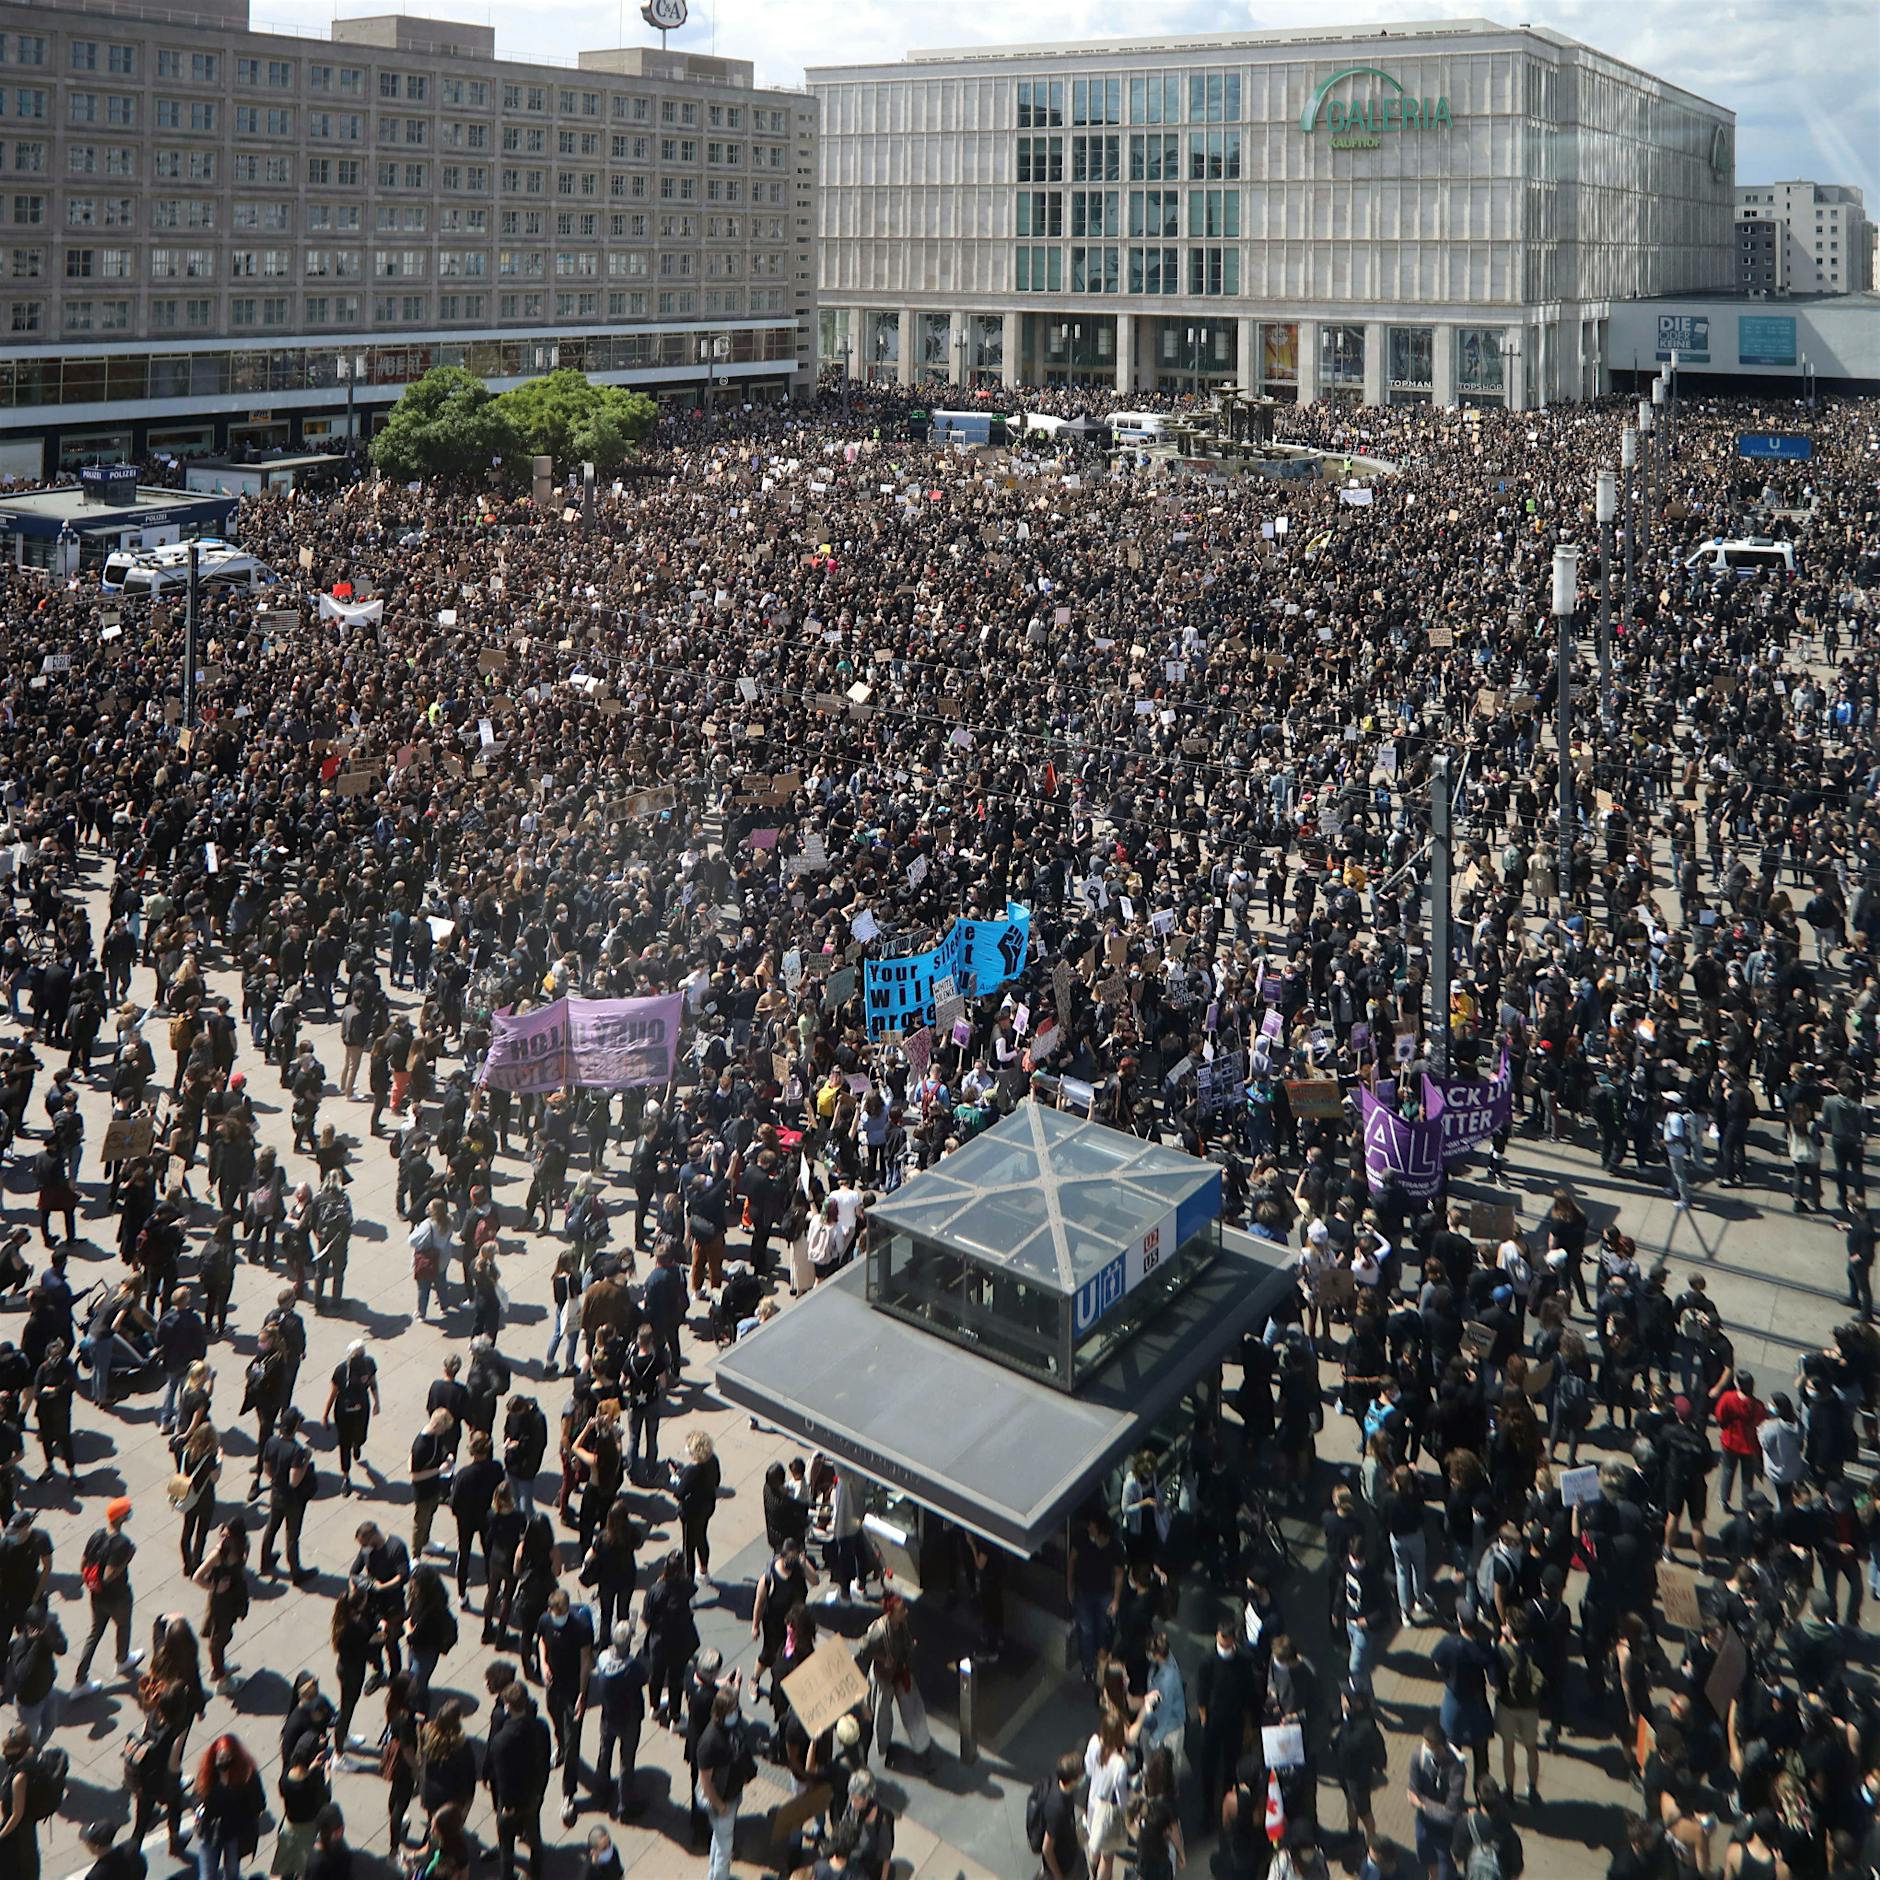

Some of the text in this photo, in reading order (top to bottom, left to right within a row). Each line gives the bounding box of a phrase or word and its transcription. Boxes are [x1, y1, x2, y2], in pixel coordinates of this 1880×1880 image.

[656, 0, 681, 19] C&A
[1327, 96, 1453, 133] GALERIA
[1328, 137, 1381, 149] KAUFHOF
[1660, 317, 1691, 331] DIE
[1660, 331, 1690, 340] ODER
[1660, 340, 1691, 348] KEINE
[1390, 379, 1432, 388] TOPMAN
[1458, 382, 1503, 390] TOPSHOP
[1769, 438, 1780, 449] U
[83, 470, 102, 480] POLIZEI
[109, 469, 137, 479] POLIZEI
[145, 513, 167, 522] POLIZEI
[870, 965, 918, 982] Your
[870, 976, 935, 1009] will
[934, 980, 953, 994] WHITE
[1145, 1249, 1157, 1270] U5
[1077, 1279, 1097, 1329] U
